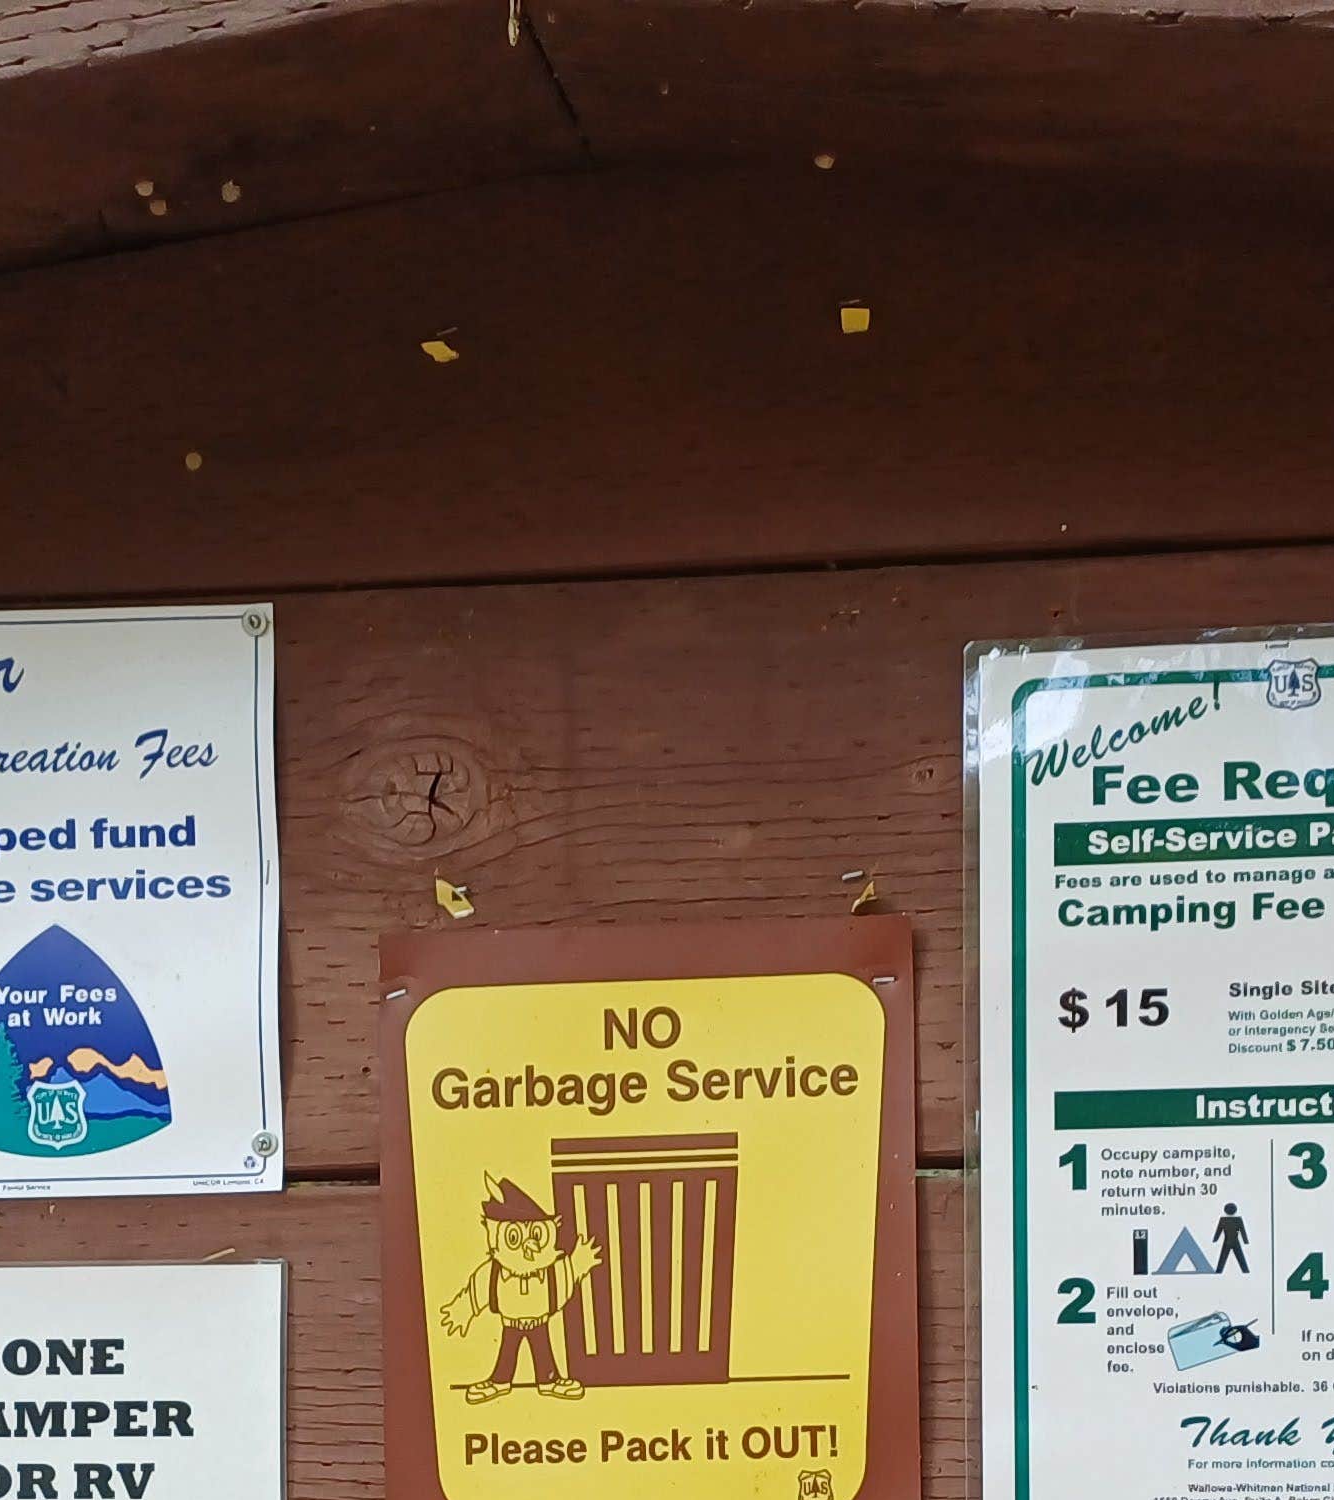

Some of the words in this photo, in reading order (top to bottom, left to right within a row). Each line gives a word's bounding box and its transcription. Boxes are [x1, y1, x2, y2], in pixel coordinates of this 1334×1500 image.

[1025, 681, 1222, 786] Welcome!
[135, 729, 218, 779] Fees
[1093, 765, 1199, 805] Fee
[90, 815, 195, 849] fund
[1088, 825, 1296, 854] Self-Service
[31, 869, 231, 902] services
[1055, 874, 1102, 889] Fees
[1110, 876, 1141, 887] are
[1150, 870, 1198, 885] used
[1206, 870, 1226, 883] to
[1234, 869, 1315, 884] manage
[1058, 896, 1235, 931] Camping
[1253, 892, 1325, 920] Fee
[61, 985, 116, 1002] Fees
[1230, 981, 1292, 1000] Single
[8, 1010, 30, 1027] at
[43, 1007, 101, 1025] Work
[604, 1007, 681, 1050] NO
[1058, 988, 1089, 1033] $
[1106, 988, 1169, 1027] 15
[432, 1065, 647, 1116] Garbage
[667, 1056, 858, 1102] Service
[1059, 1144, 1087, 1190] 1
[1101, 1149, 1158, 1163] Occupy
[1163, 1146, 1235, 1161] campsite,
[1102, 1168, 1133, 1179] note
[1139, 1166, 1199, 1179] number,
[1204, 1164, 1231, 1176] and
[1288, 1142, 1327, 1189] 3
[1102, 1186, 1145, 1197] return
[1151, 1184, 1195, 1196] within
[1201, 1183, 1217, 1195] 30
[1102, 1203, 1165, 1216] minutes.
[1287, 1252, 1329, 1299] 4
[1057, 1278, 1096, 1324] 2
[2, 1339, 124, 1375] ONE
[1153, 1383, 1220, 1393] Violations
[1226, 1381, 1304, 1396] punishable.
[1313, 1381, 1328, 1392] 36
[465, 1433, 587, 1465] Please
[601, 1429, 692, 1462] Pack
[707, 1428, 729, 1460] it
[742, 1425, 837, 1459] OUT!
[1181, 1417, 1301, 1447] Thank
[74, 1463, 154, 1499] RV
